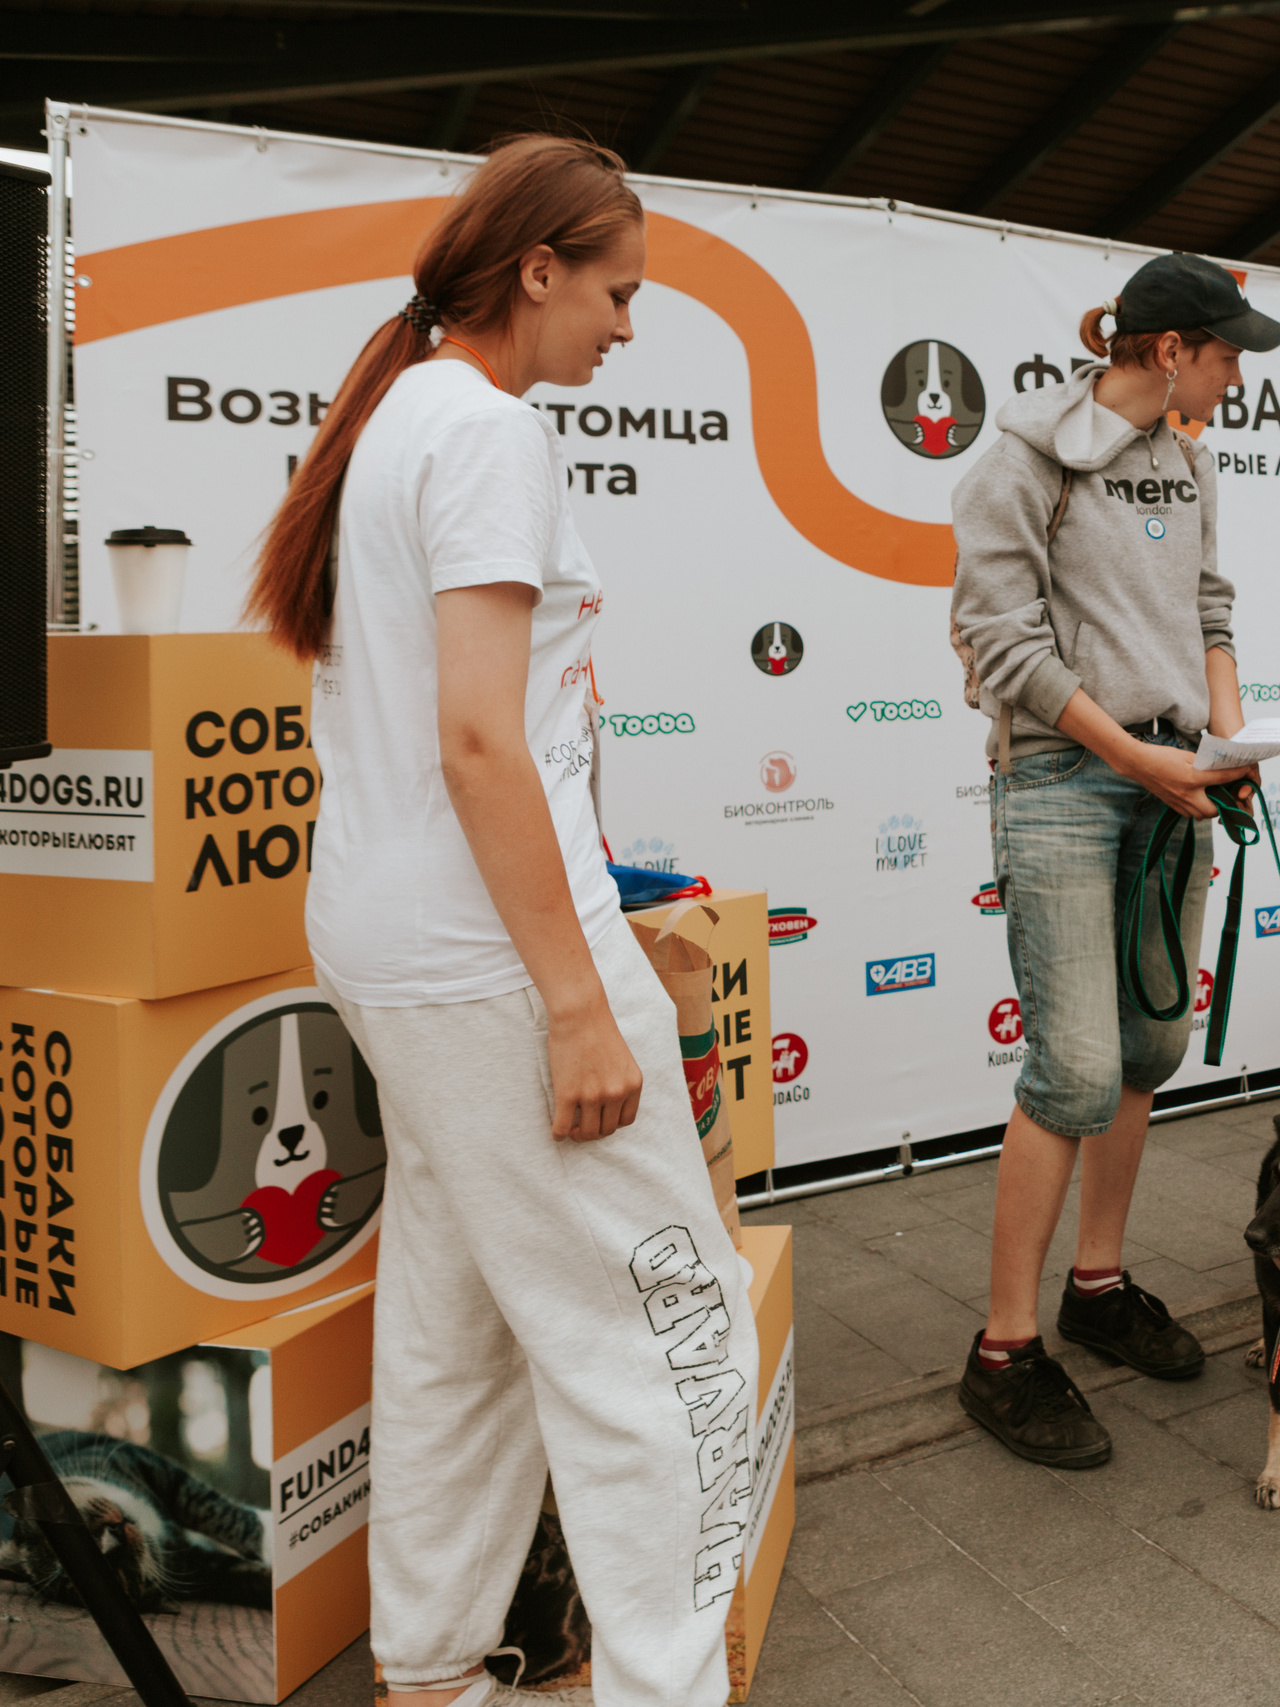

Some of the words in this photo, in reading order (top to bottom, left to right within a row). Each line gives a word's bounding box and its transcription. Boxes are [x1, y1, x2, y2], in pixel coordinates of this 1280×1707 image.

[531, 403, 728, 444] томца
[1103, 477, 1197, 504] merc
[1136, 505, 1172, 515] london
[870, 699, 942, 721] Tooba
[186, 705, 312, 758] СОБ
[609, 712, 695, 737] Tooba
[185, 767, 323, 819] КОТО
[724, 798, 834, 819] БИОКОНТРОЛЬ
[887, 833, 927, 854] LOVE
[903, 853, 927, 869] PET
[11, 1022, 39, 1309] КОТОРЫЕ
[44, 1030, 76, 1317] СОБАКИ
[629, 1224, 753, 1613] HARVARD
